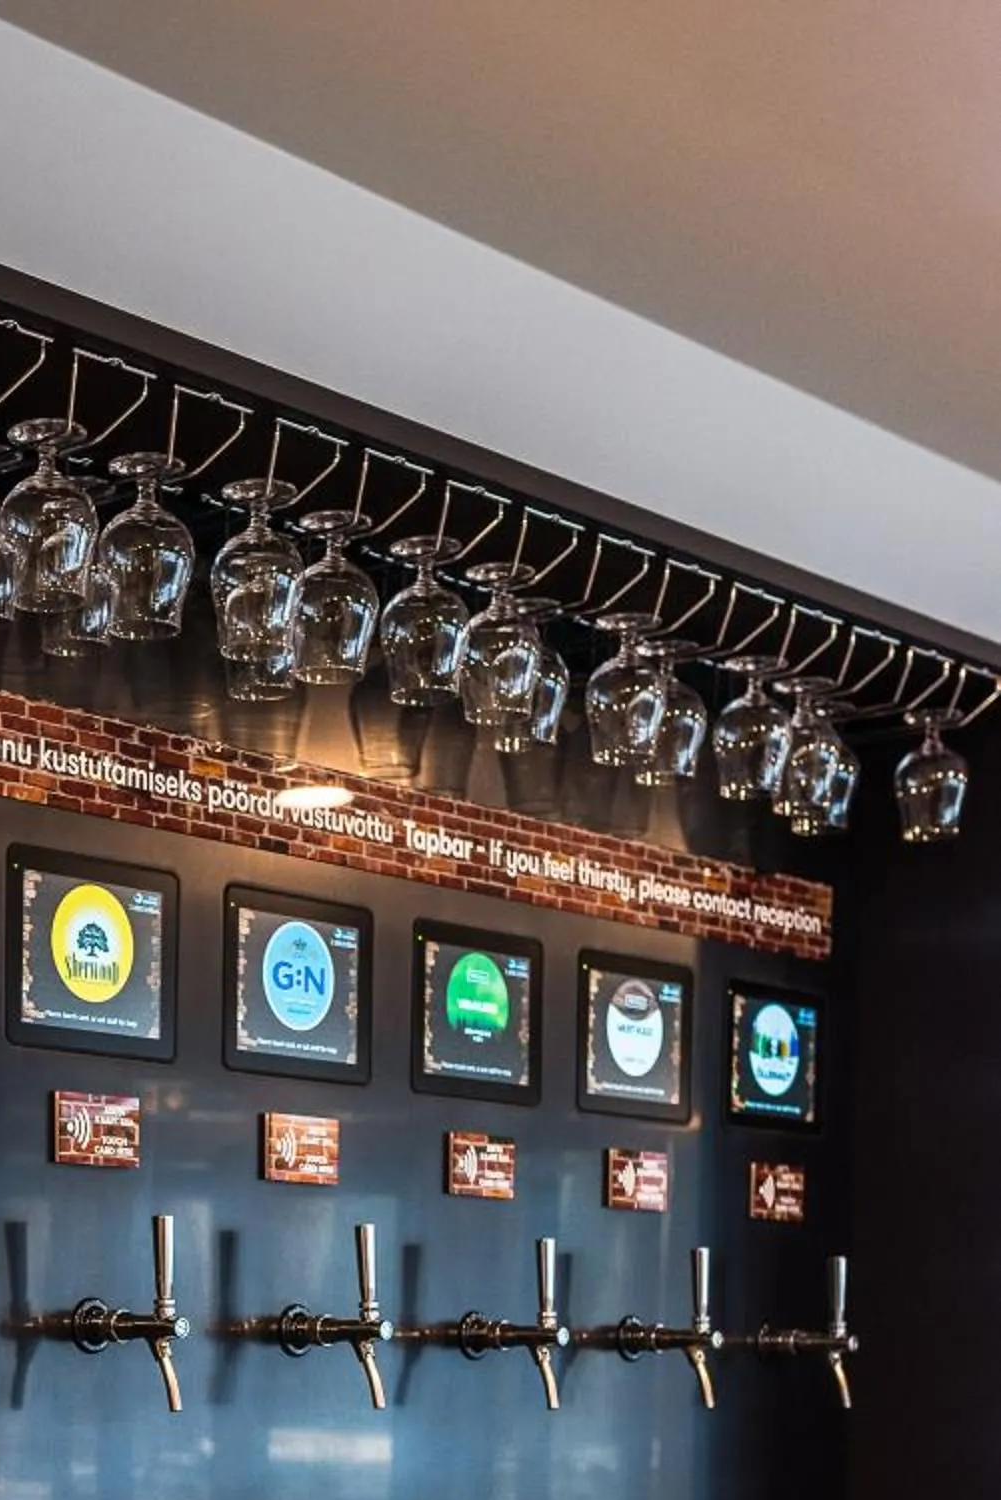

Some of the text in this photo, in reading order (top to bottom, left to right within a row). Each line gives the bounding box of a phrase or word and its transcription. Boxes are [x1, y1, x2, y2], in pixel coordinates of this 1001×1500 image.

[39, 740, 202, 803] kustutamiseks
[208, 779, 286, 822] pöördu
[290, 806, 393, 844] vastuvõttu
[402, 819, 472, 860] Tapbar
[490, 839, 504, 867] If
[506, 850, 539, 878] you
[543, 851, 575, 883] feel
[578, 863, 636, 900] thirsty,
[639, 874, 691, 907] please
[692, 889, 751, 919] contact
[753, 906, 822, 935] reception
